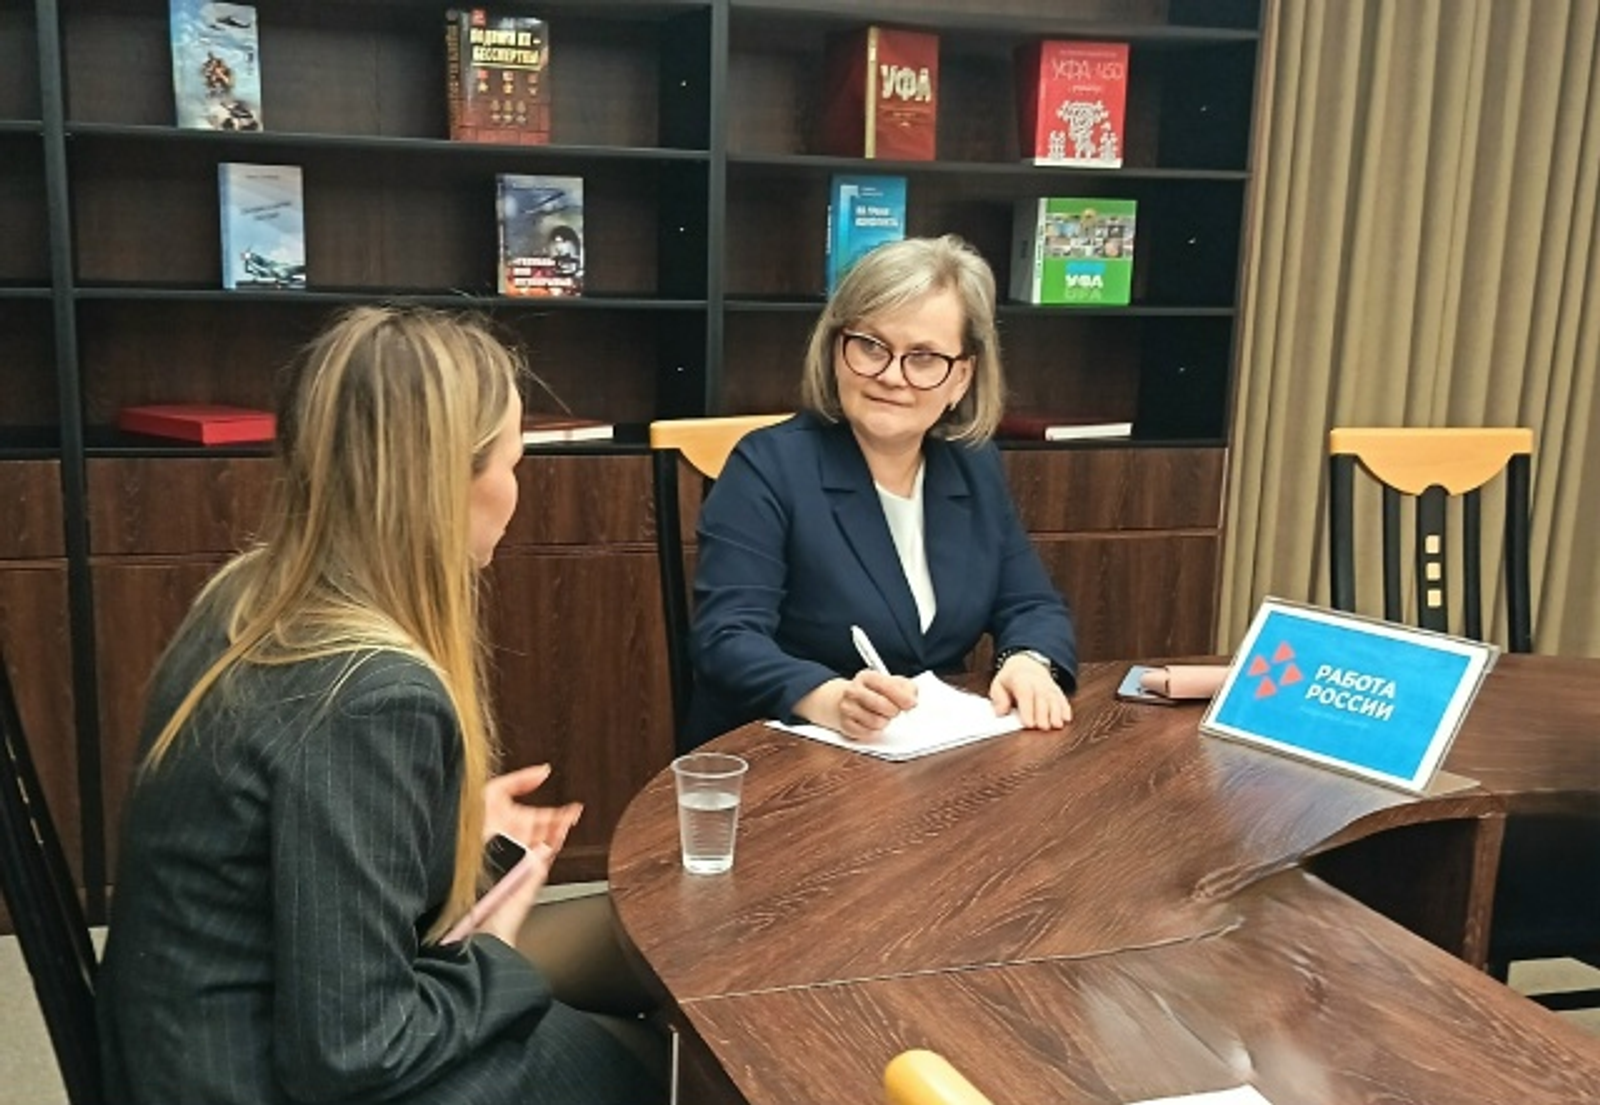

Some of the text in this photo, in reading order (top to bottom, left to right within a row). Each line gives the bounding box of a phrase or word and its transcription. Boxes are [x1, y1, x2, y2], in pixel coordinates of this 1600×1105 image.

[880, 64, 932, 103] УФА
[1065, 275, 1104, 288] УФА
[1314, 664, 1397, 699] РАБОТА
[1304, 683, 1396, 722] РОССИИ
